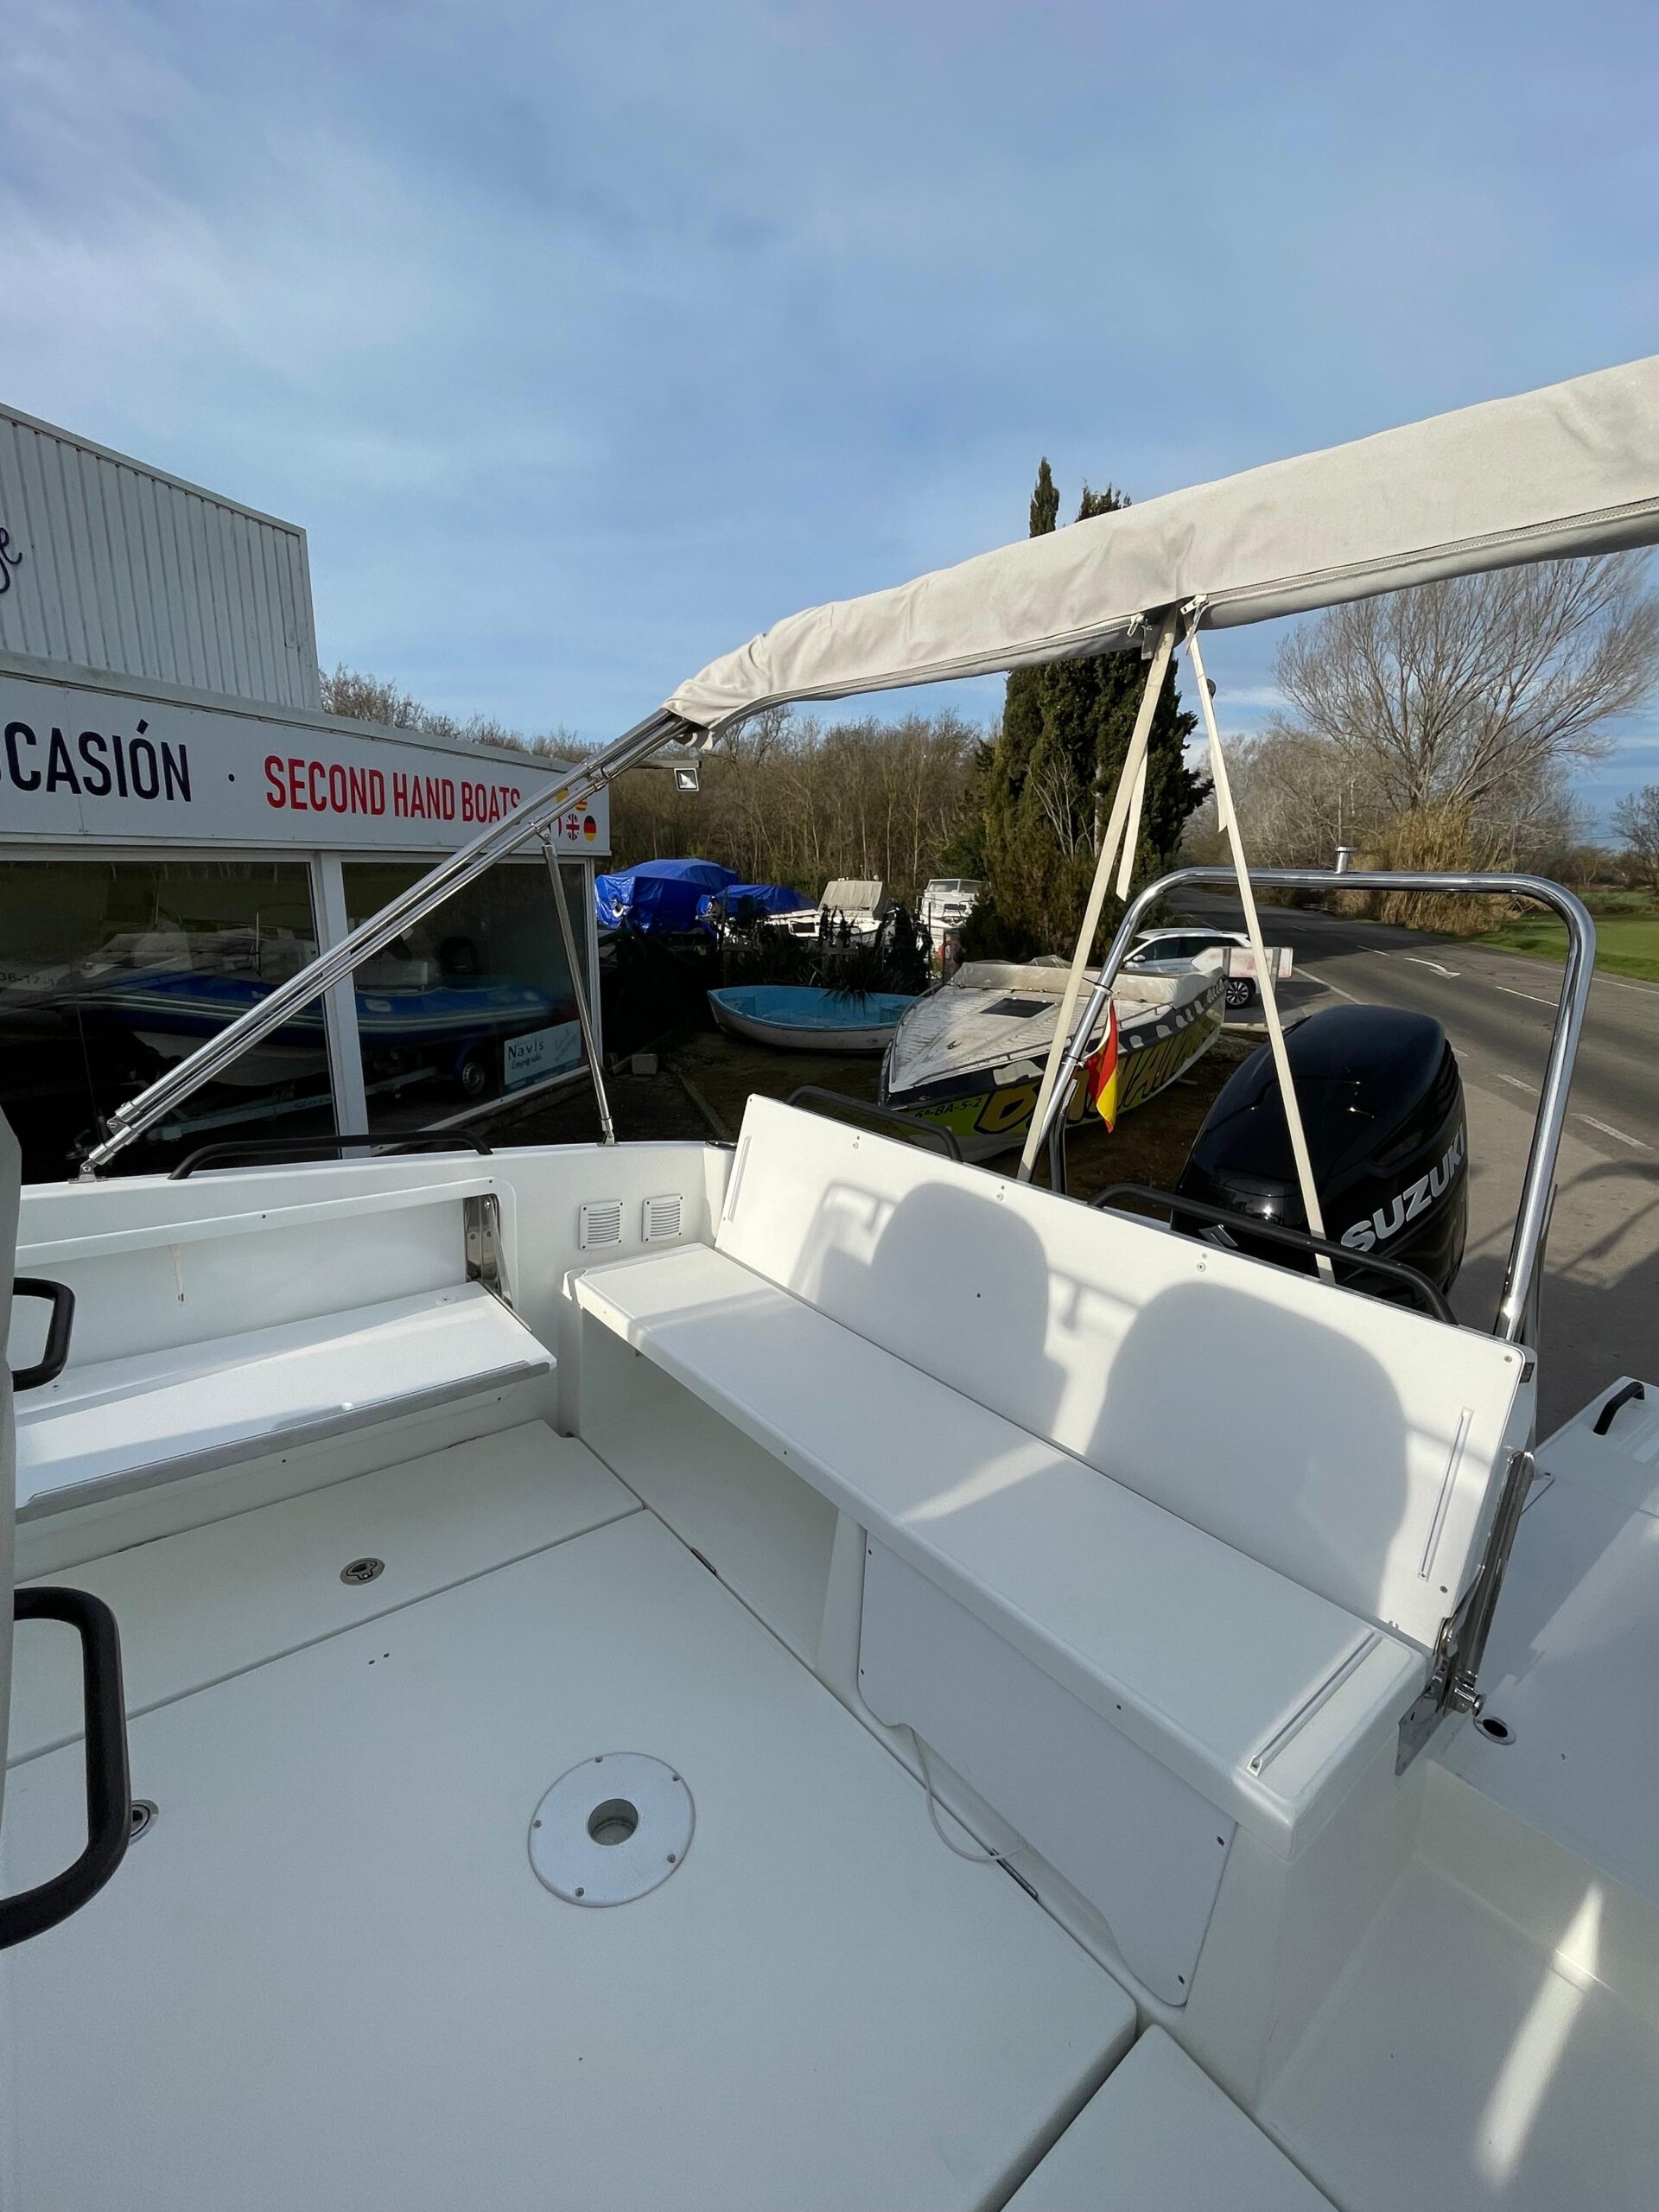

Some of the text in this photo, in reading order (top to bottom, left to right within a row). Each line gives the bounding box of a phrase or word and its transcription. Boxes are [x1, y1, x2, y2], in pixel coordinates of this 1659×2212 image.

[0, 719, 192, 802] CASIÓN
[264, 754, 521, 824] SECOND HAND BOATS
[1341, 1123, 1465, 1252] SUZUKI
